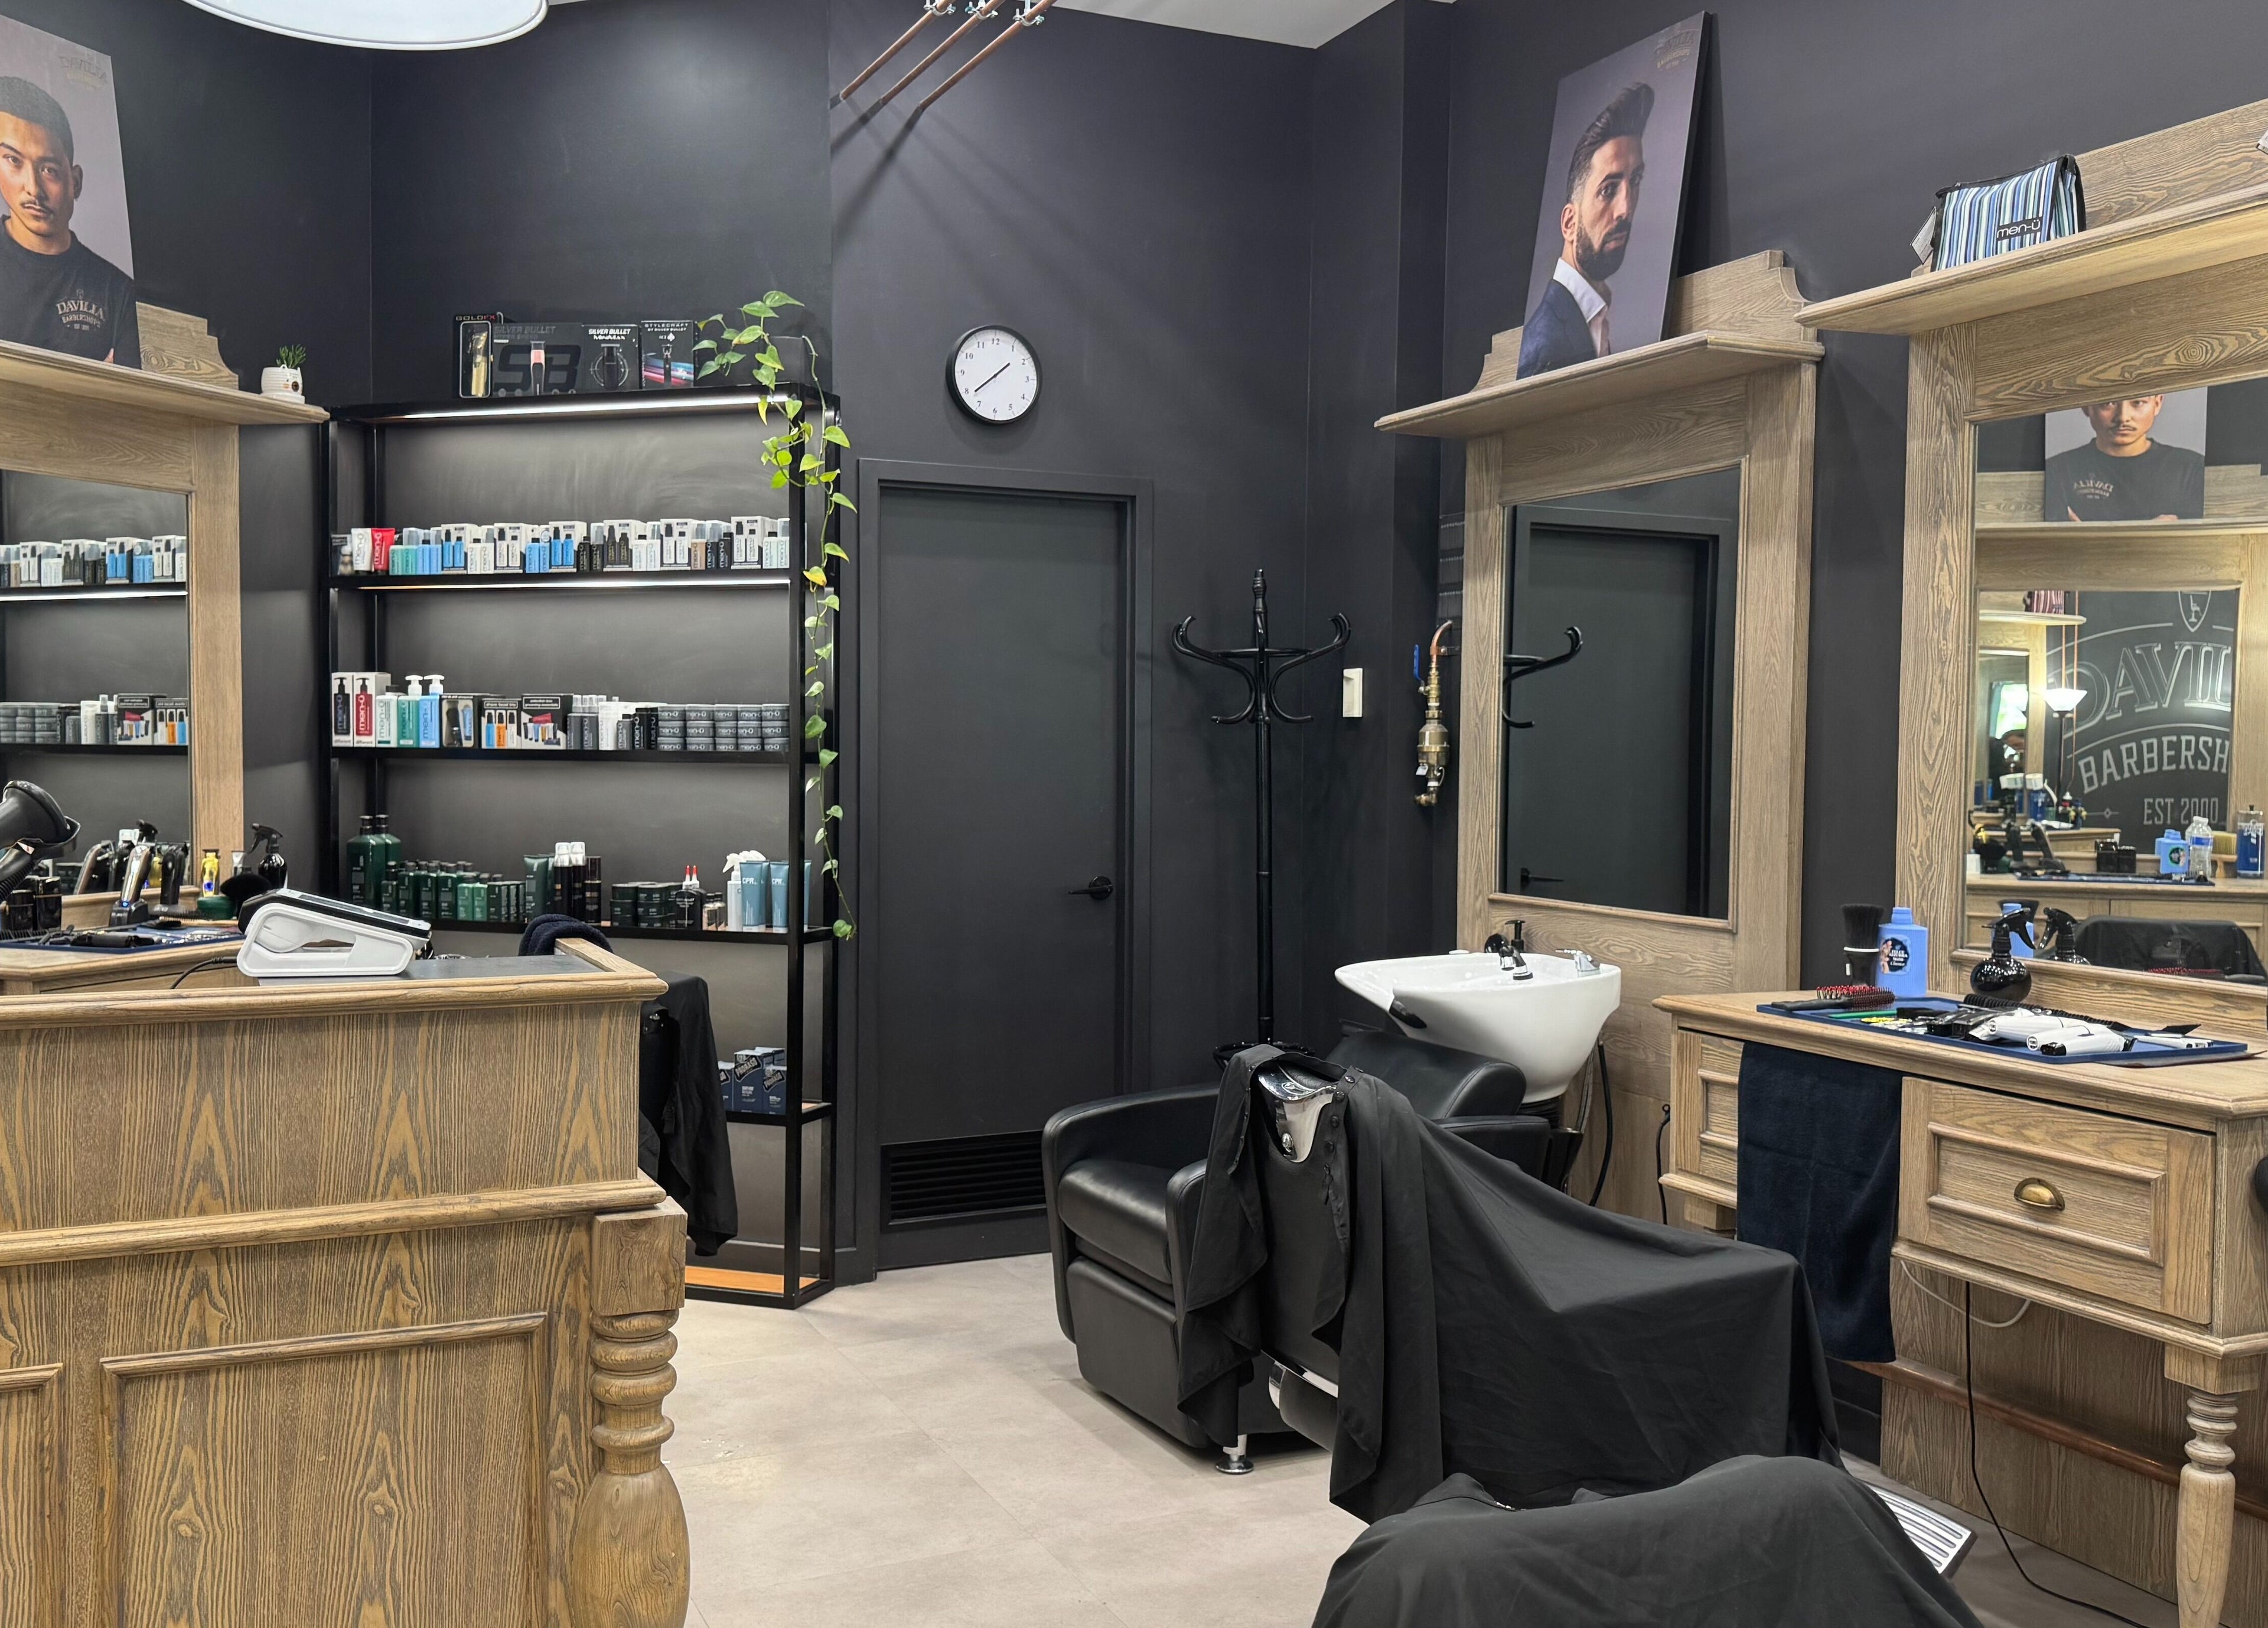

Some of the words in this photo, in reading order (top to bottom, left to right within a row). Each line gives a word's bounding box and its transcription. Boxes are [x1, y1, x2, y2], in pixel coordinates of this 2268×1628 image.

[2078, 735, 2230, 794] BARBERSH
[2143, 798, 2174, 825] EST
[2181, 797, 2218, 825] 2000
